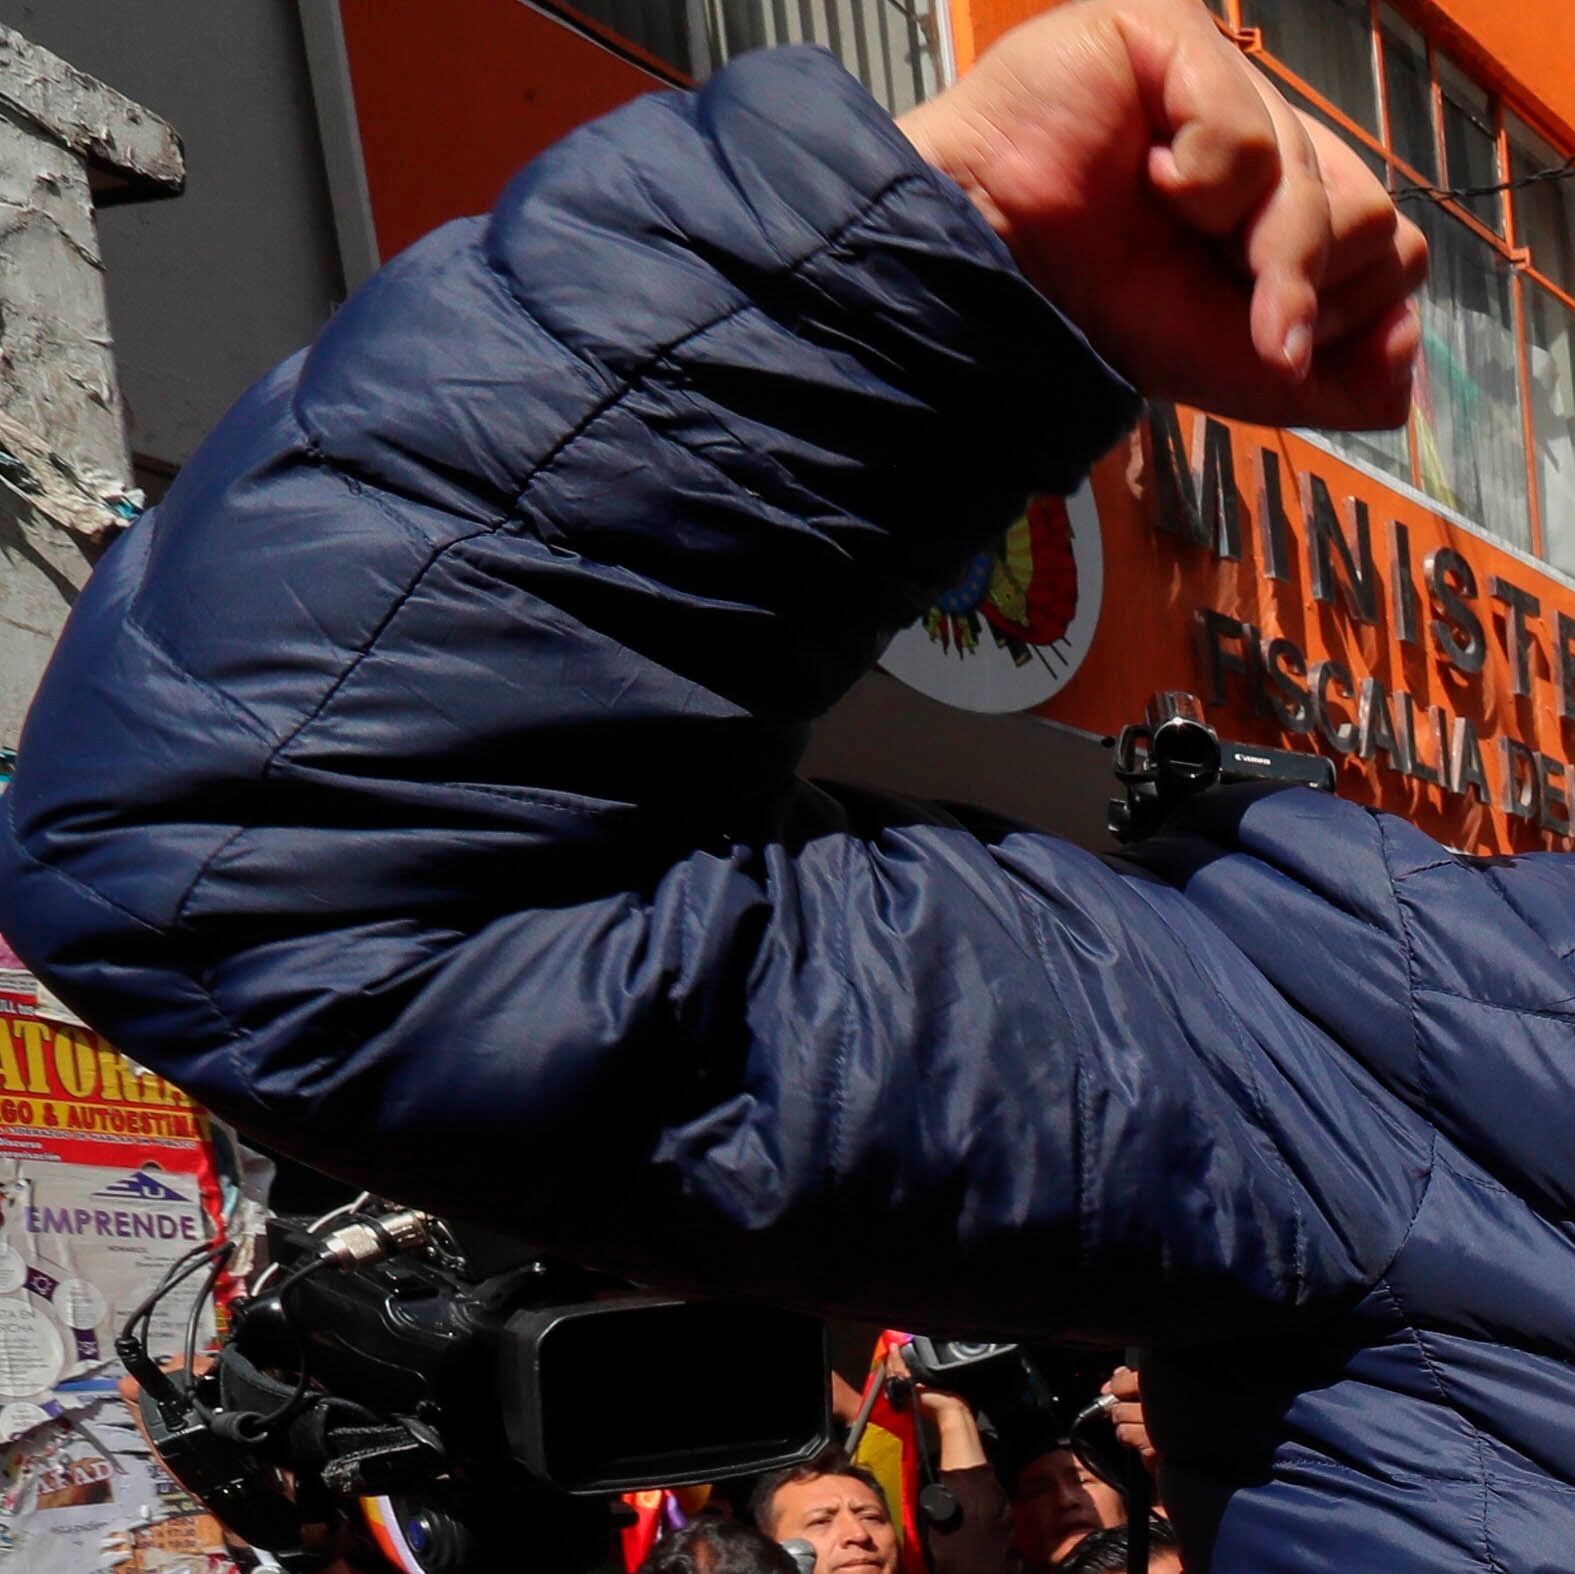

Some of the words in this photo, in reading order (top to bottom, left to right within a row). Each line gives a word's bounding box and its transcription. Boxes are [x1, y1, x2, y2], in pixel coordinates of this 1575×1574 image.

[1197, 608, 1491, 804] FISCALIA
[1234, 752, 1271, 766] Canon
[43, 1103, 59, 1127] &
[25, 1205, 200, 1241] EMPRENDE
